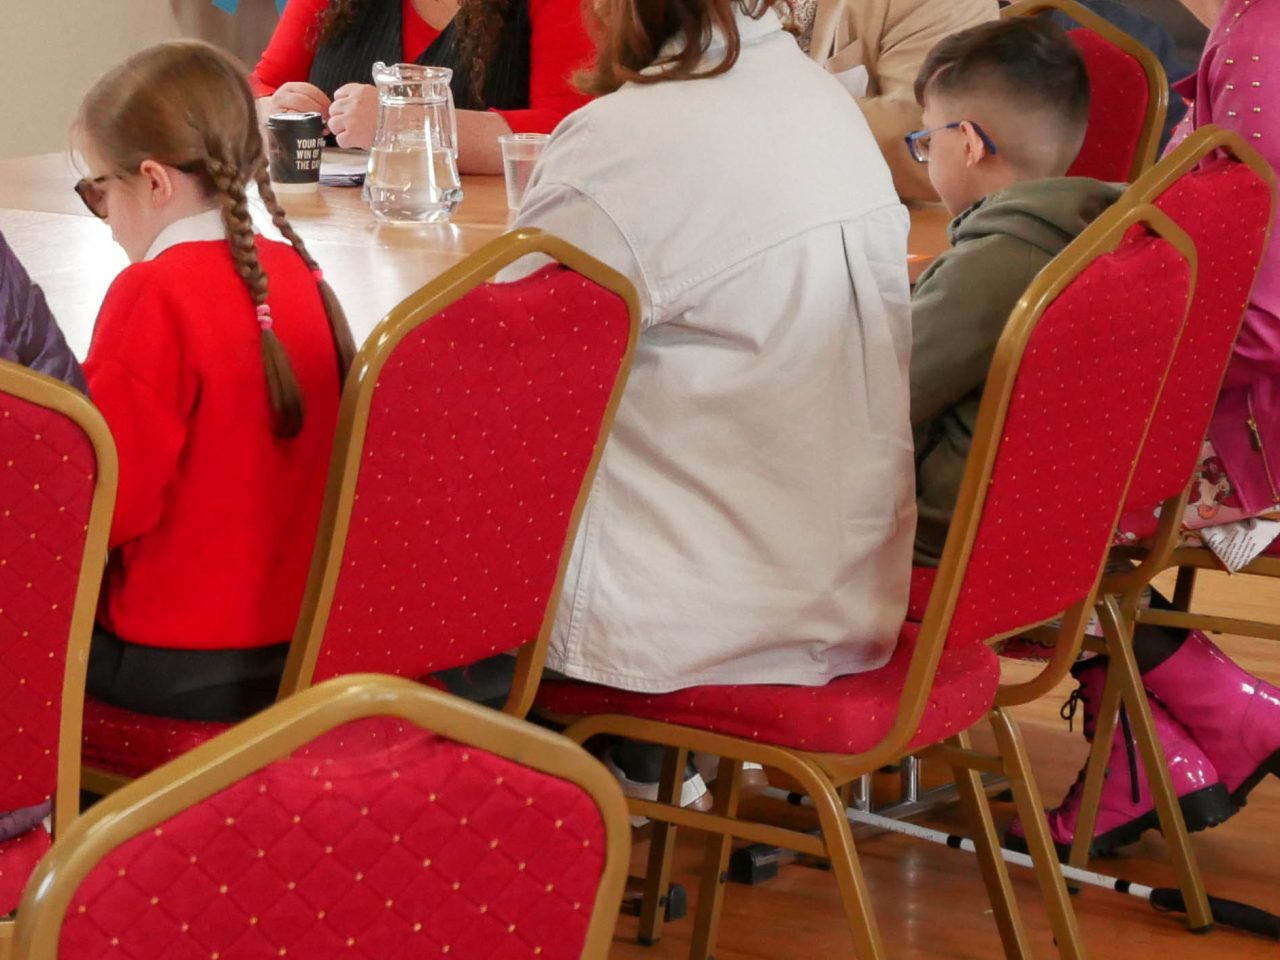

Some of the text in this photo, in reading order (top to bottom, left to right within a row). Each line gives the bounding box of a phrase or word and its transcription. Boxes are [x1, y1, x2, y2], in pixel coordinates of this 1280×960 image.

[296, 138, 316, 149] YOUR
[296, 149, 312, 159] WIN
[296, 160, 310, 170] THE
